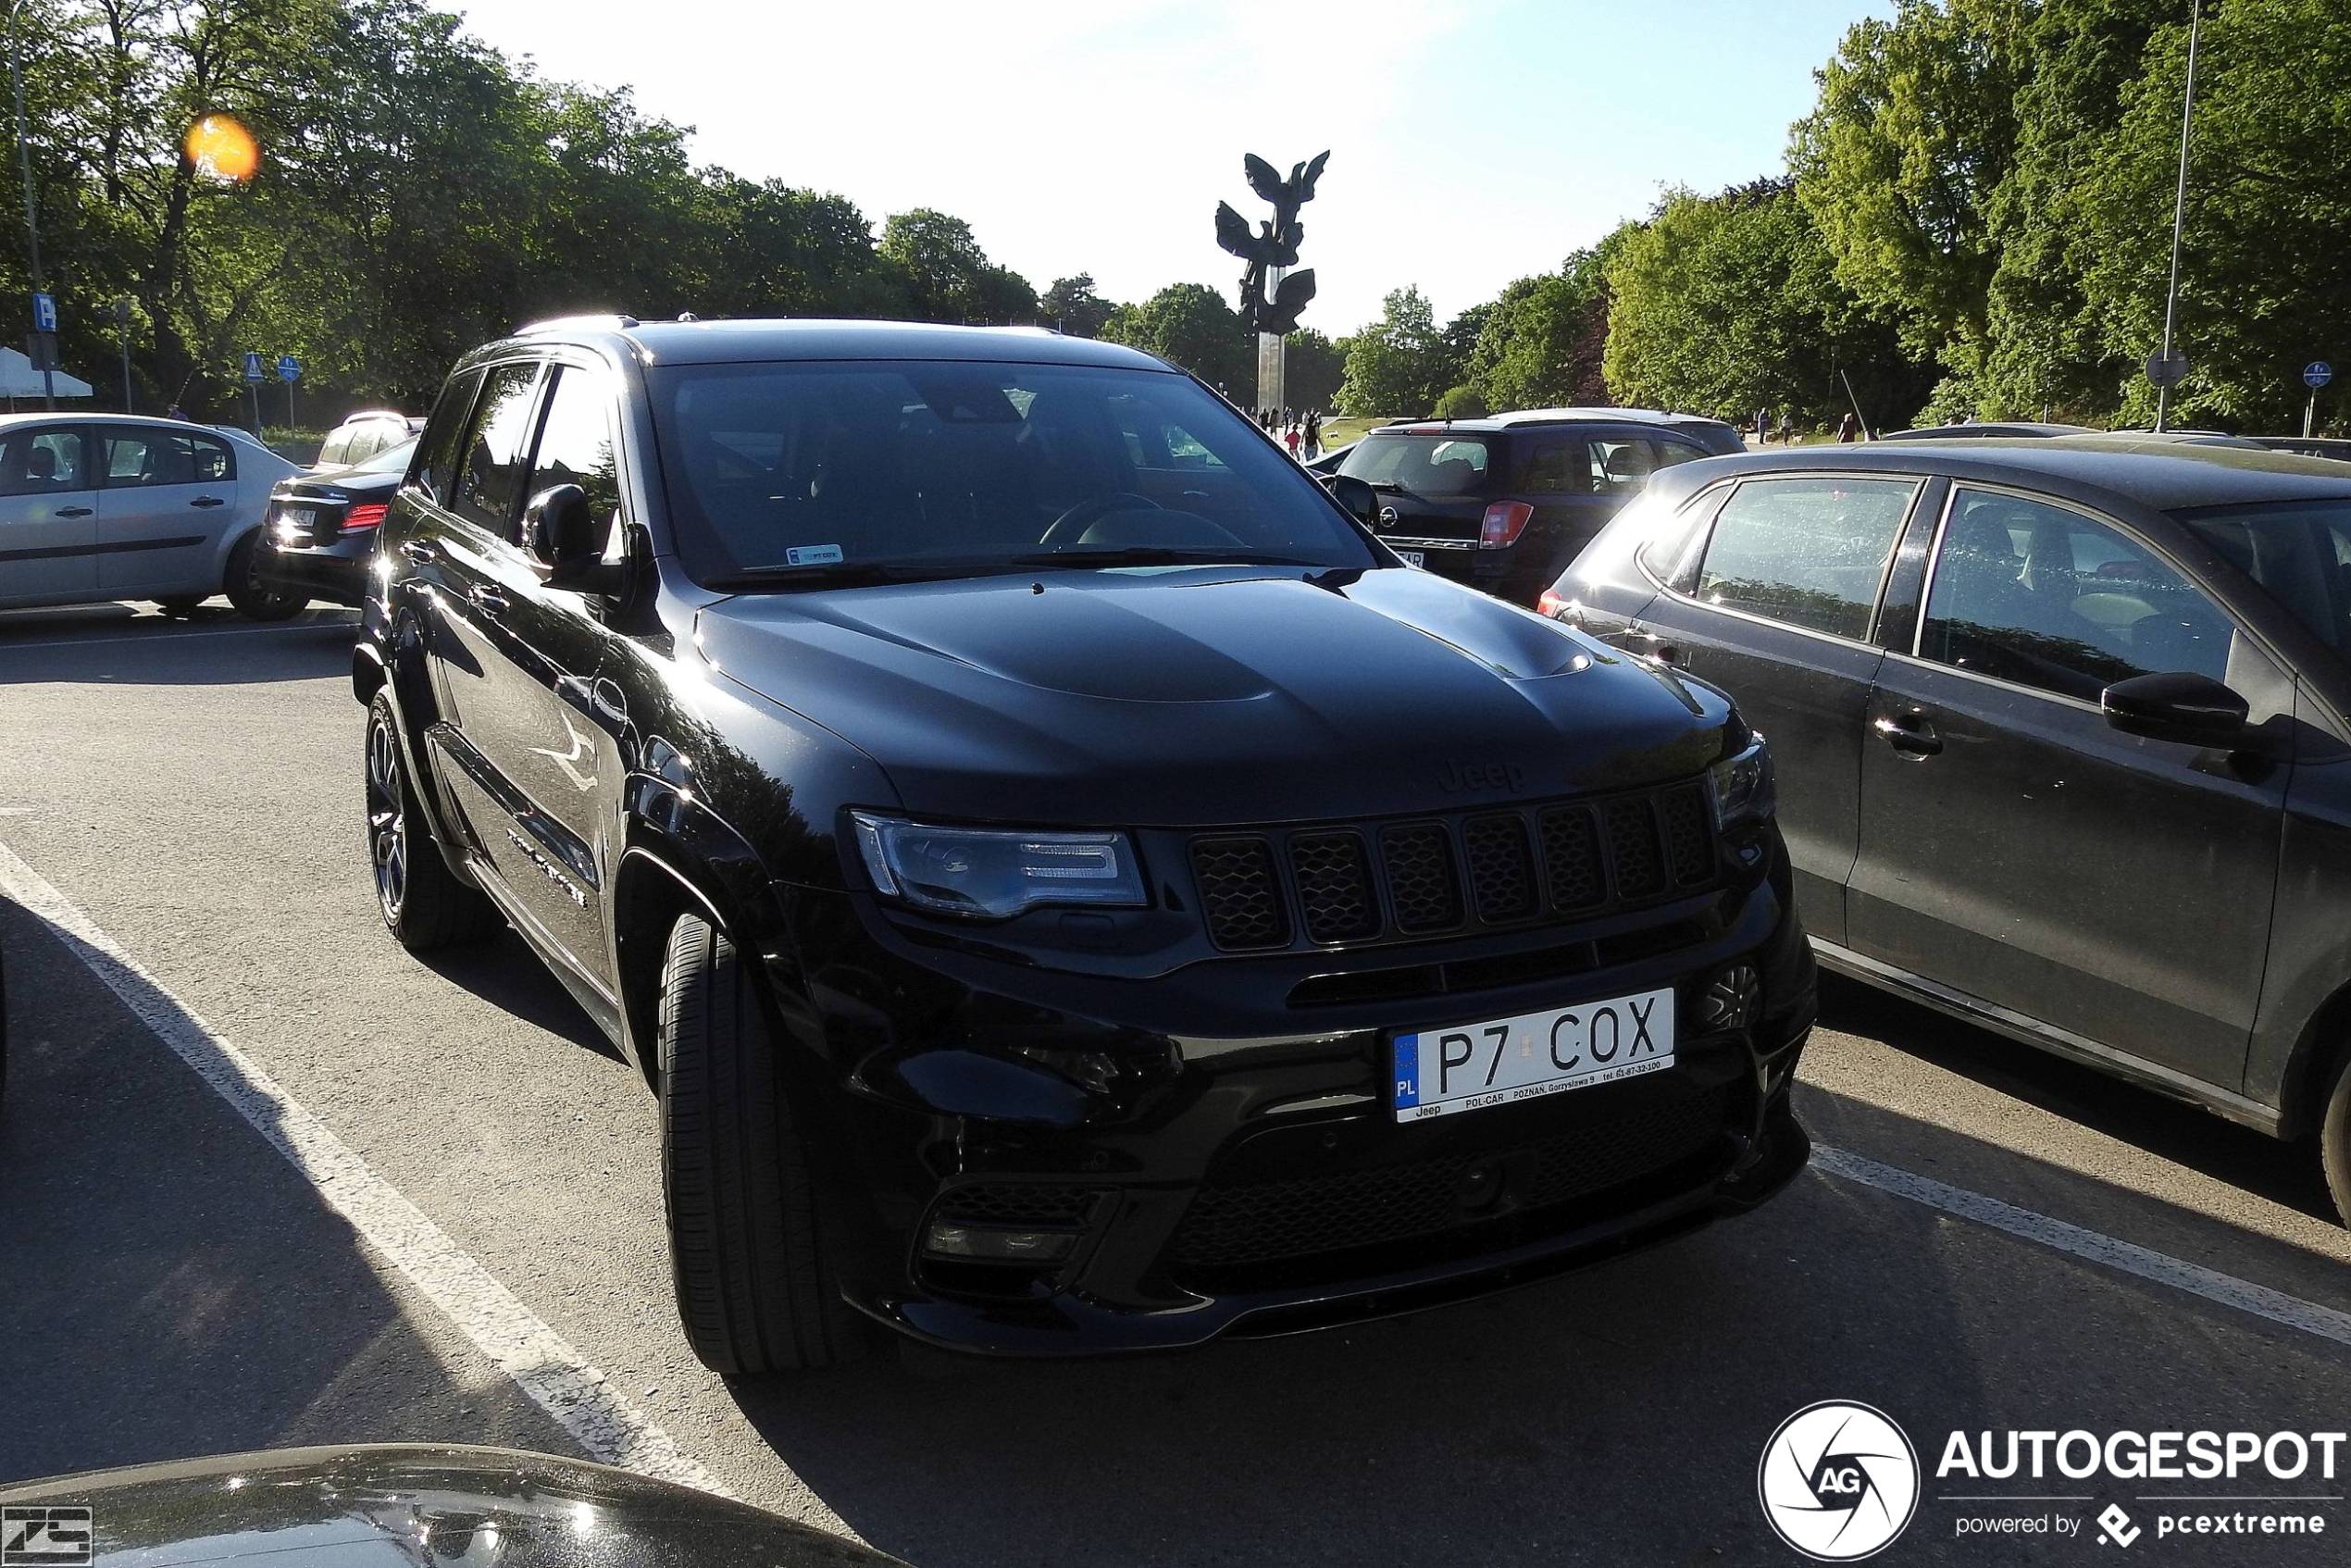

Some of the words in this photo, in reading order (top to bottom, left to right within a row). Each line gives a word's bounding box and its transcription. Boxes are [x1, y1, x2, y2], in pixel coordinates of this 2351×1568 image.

[1398, 553, 1422, 567] AR
[1439, 1025, 1510, 1094] P7
[1549, 997, 1656, 1071] COX
[1397, 1079, 1415, 1097] PL
[1415, 1105, 1441, 1117] Jeep
[1465, 1093, 1505, 1109] POL-CAR
[1589, 1076, 1596, 1084] 9
